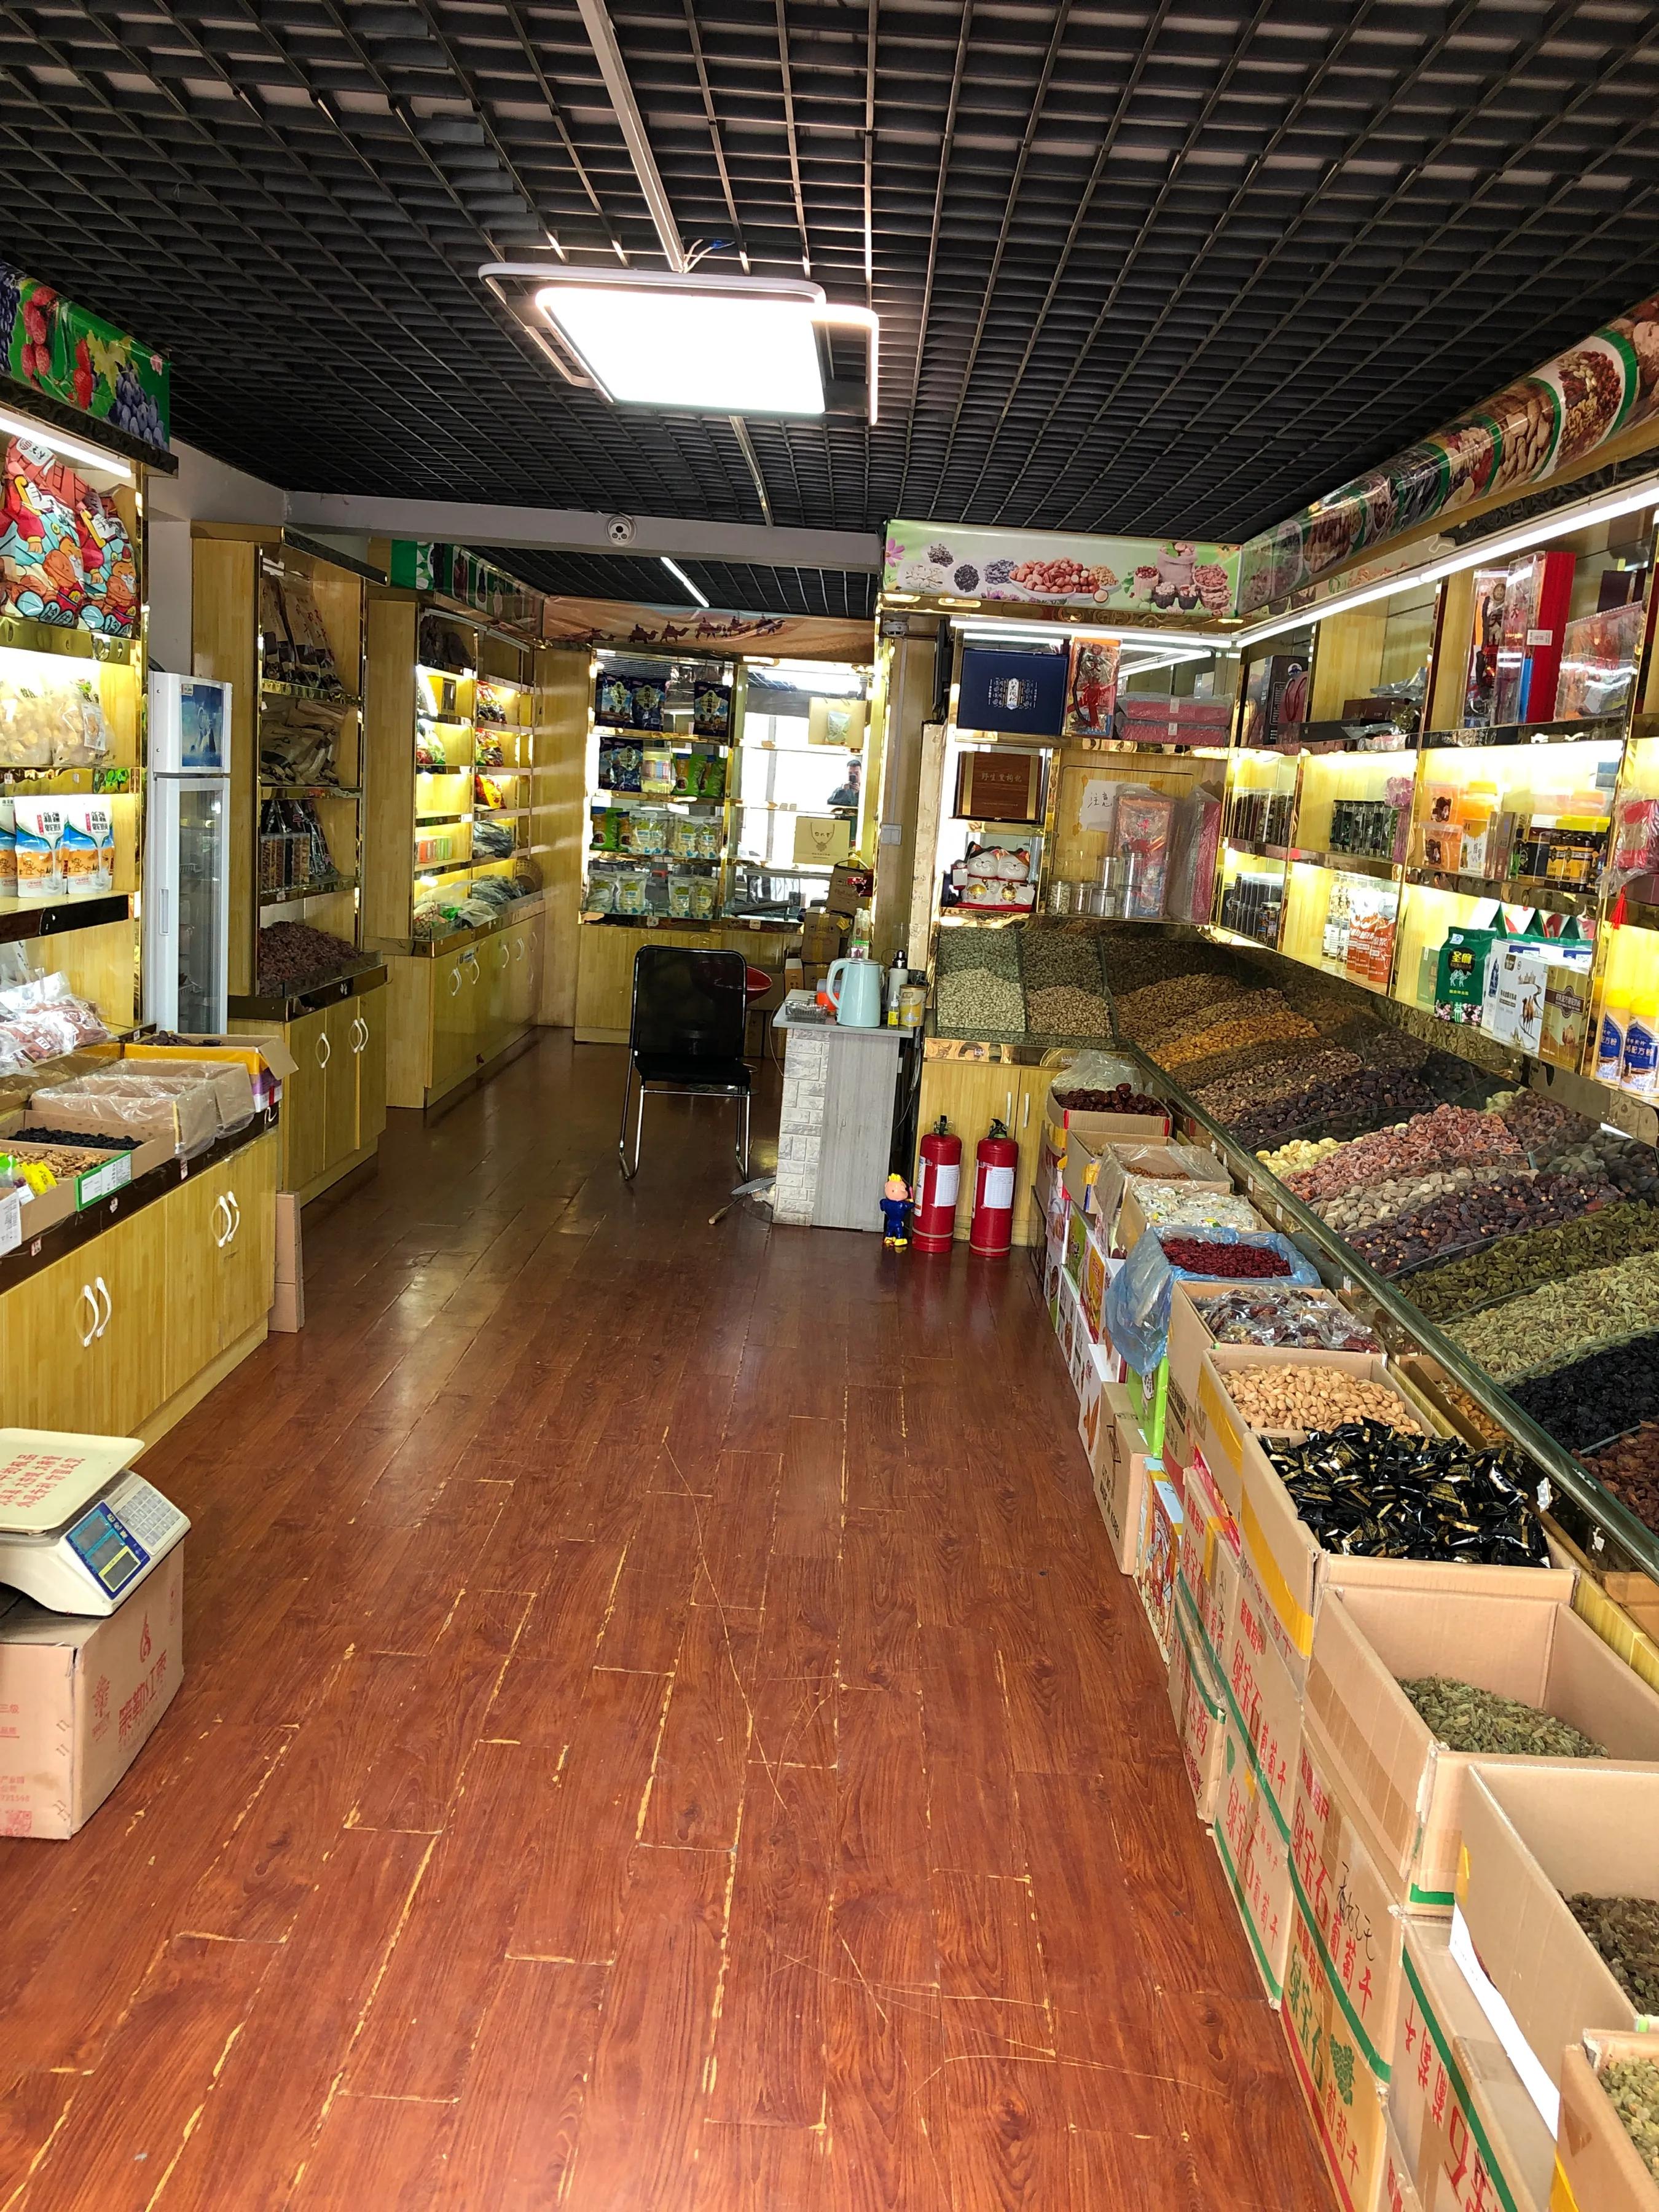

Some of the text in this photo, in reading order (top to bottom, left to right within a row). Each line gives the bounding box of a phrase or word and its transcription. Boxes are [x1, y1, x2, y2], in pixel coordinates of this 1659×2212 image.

[44, 812, 60, 822] 新疆
[1231, 1639, 1287, 1802] 绿宝石 葡萄干
[1226, 1776, 1279, 1952] 绿宝石 葡萄干
[1293, 1796, 1374, 2020] 绿宝石 葡萄干
[1289, 1943, 1360, 2176] 绿宝石 葡萄干
[1404, 1998, 1449, 2130] 葡萄干
